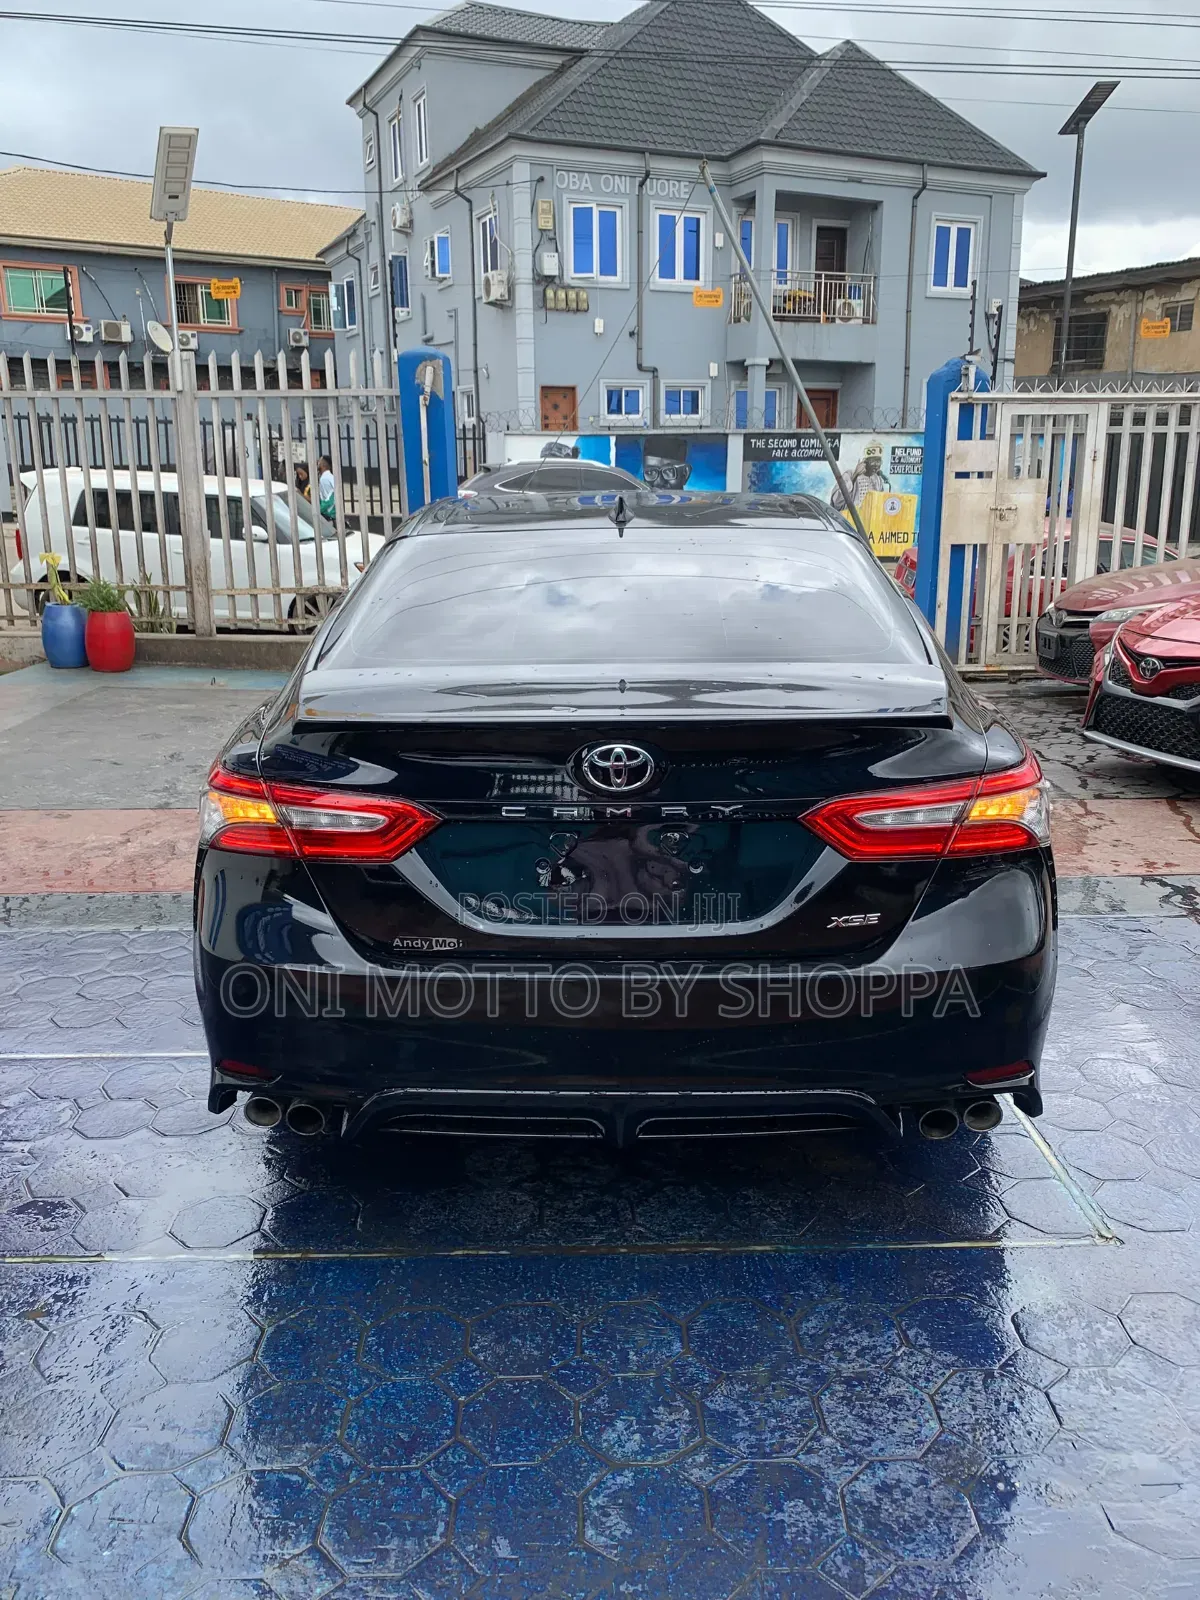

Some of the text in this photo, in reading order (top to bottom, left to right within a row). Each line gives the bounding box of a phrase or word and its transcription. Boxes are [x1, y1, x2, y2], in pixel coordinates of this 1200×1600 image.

[556, 171, 593, 192] OBA
[601, 174, 630, 194] ONI
[751, 439, 765, 448] THE
[767, 439, 797, 449] SECOND
[878, 531, 909, 544] AHMED
[502, 804, 743, 818] CAMRY
[826, 912, 881, 929] XSE
[393, 938, 430, 950] Andy
